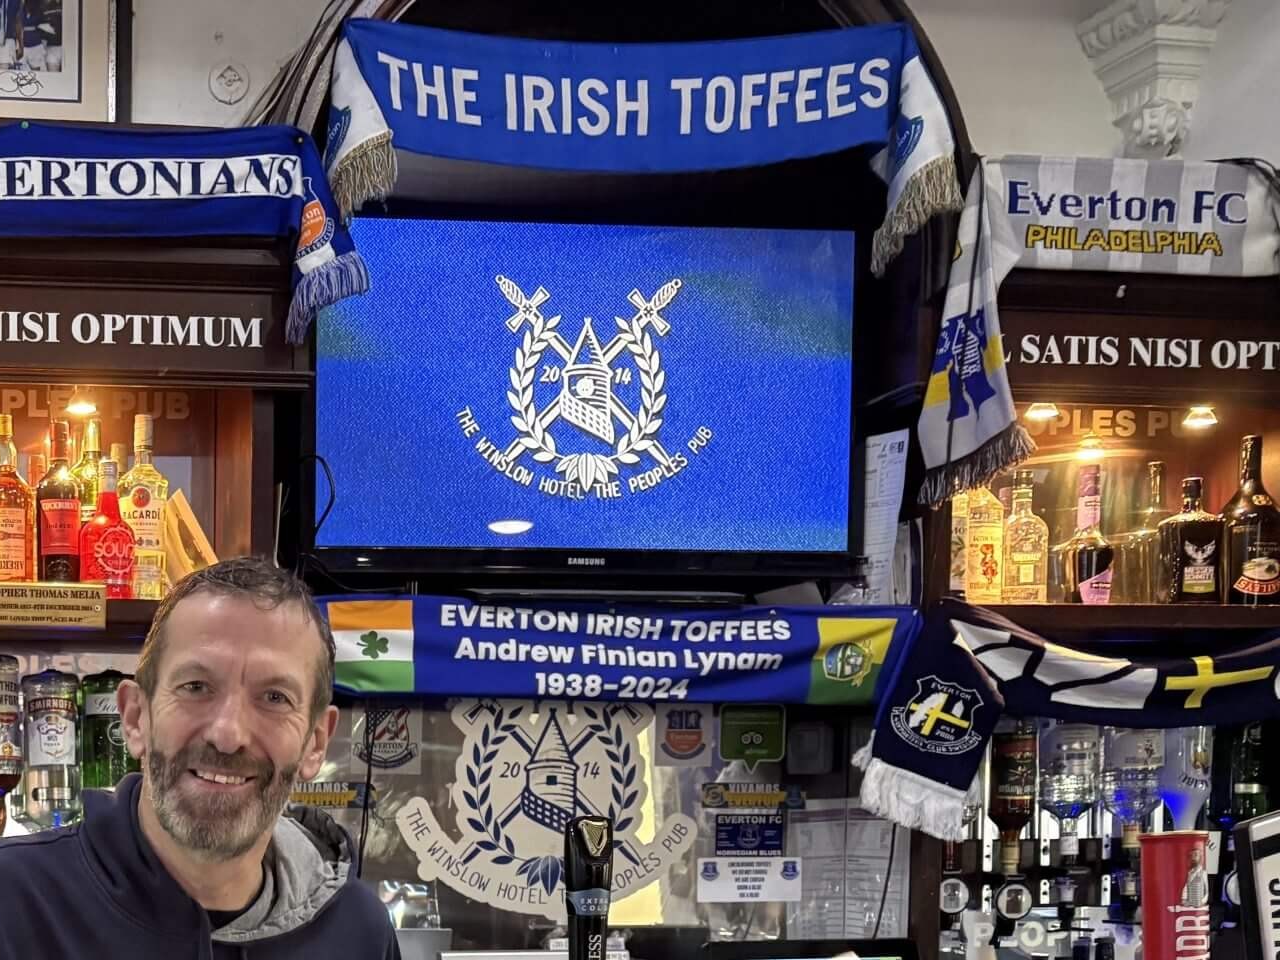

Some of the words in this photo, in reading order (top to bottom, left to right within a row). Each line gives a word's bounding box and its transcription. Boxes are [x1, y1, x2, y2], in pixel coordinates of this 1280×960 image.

[377, 51, 481, 126] THE
[506, 73, 648, 137] IRISH
[670, 57, 890, 134] TOFFEES
[1007, 180, 1175, 223] Everton
[1193, 192, 1247, 225] FC
[1026, 225, 1223, 256] PHILADELPHIA
[70, 313, 263, 347] OPTIMUM
[1021, 334, 1118, 366] SATIS
[1128, 336, 1201, 369] NISI
[540, 366, 560, 383] 20
[615, 368, 632, 384] 14
[112, 392, 189, 419] PUB
[456, 406, 480, 438] THE
[475, 437, 534, 486] WINSLOW
[538, 477, 584, 500] HOTEL
[594, 481, 621, 499] THE
[628, 453, 688, 493] PEOPLES
[687, 425, 713, 454] PUB
[567, 557, 606, 566] SAMSUNG
[29, 588, 69, 599] THOMAS
[71, 590, 101, 599] MELIA
[1237, 580, 1280, 595] AILEYS
[441, 604, 578, 633] EVERTON
[586, 613, 662, 640] IRISH
[669, 618, 791, 643] TOFFEES
[454, 637, 576, 665] Andrew
[582, 643, 678, 670] Finian
[684, 648, 784, 675] Lynam
[535, 672, 689, 700] 1938-2024
[499, 762, 521, 778] 20
[583, 762, 601, 779] 14
[717, 815, 766, 824] EVERTON
[769, 815, 782, 824] FC
[661, 822, 689, 853] PUB
[406, 807, 431, 840] THE
[426, 841, 491, 892] WINSLOW
[497, 882, 548, 905] HOTEL
